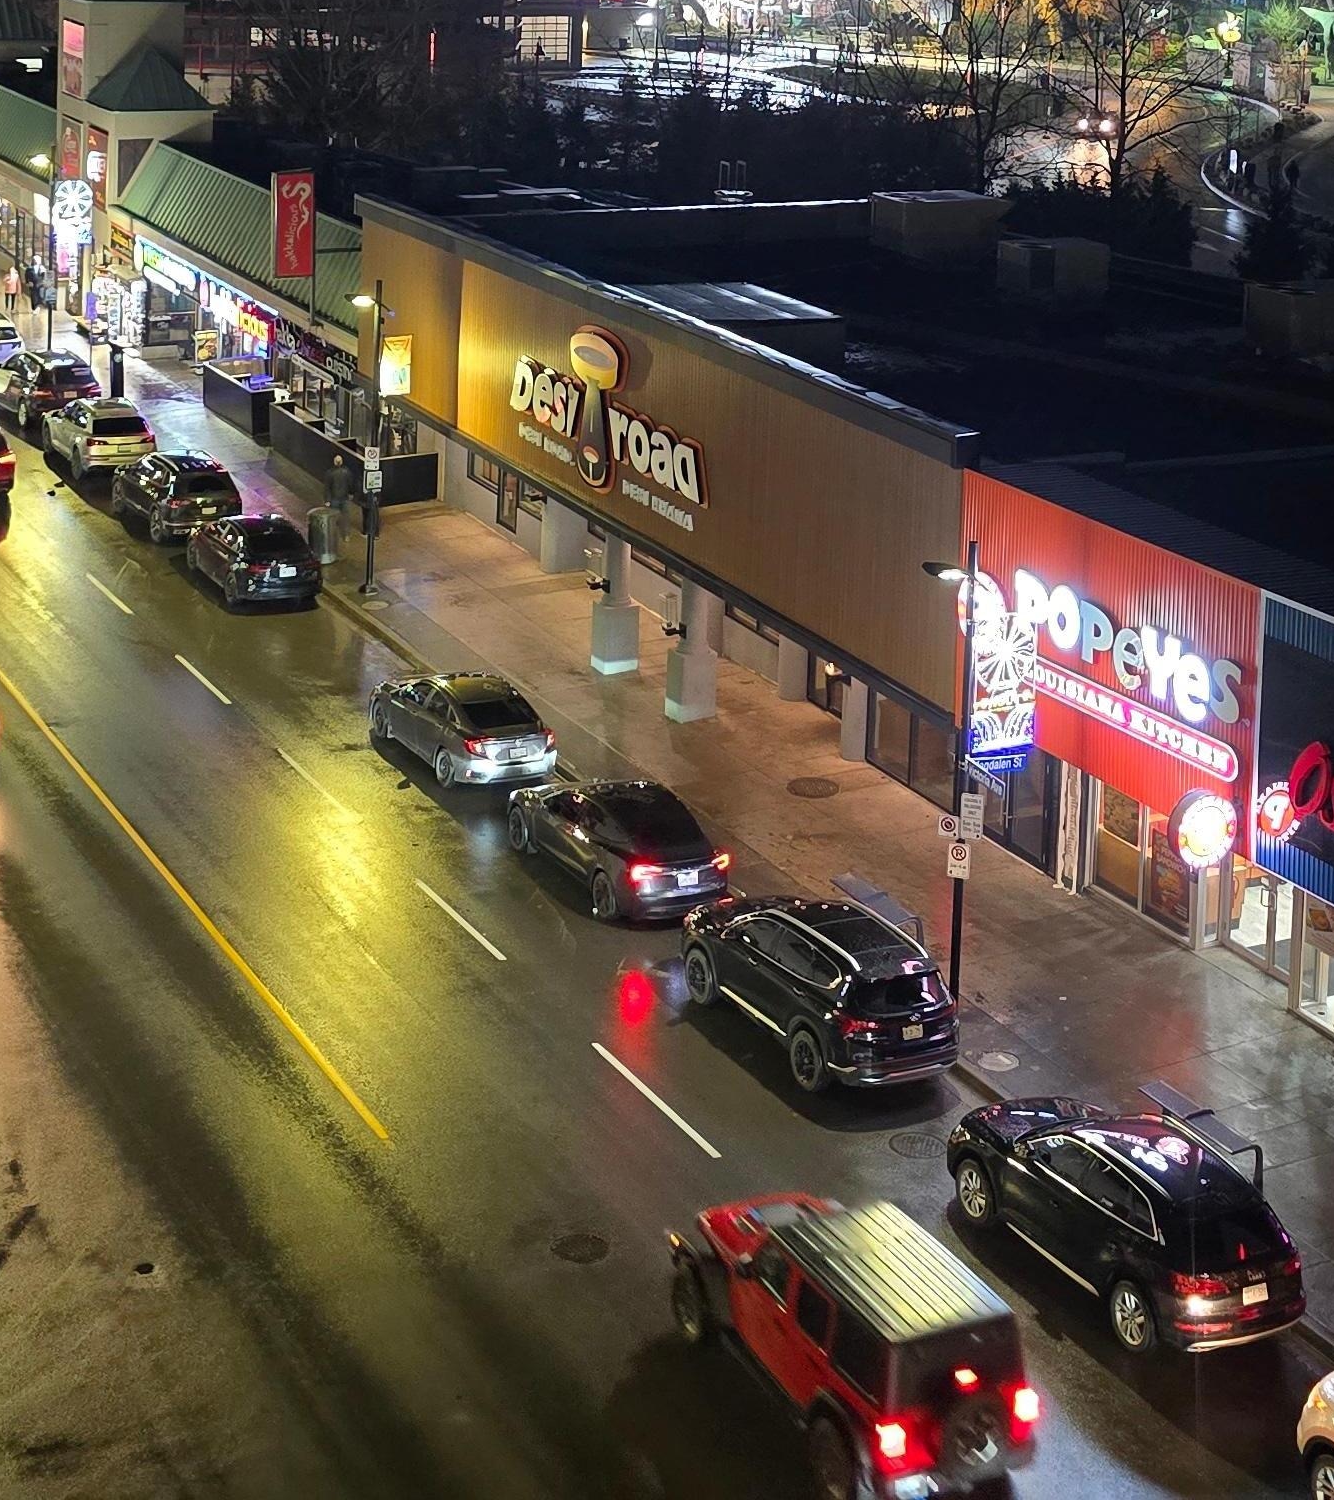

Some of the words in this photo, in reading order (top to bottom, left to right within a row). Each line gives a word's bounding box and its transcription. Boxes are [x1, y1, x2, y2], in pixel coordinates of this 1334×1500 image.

[608, 406, 699, 505] road
[978, 758, 1011, 772] agdalen
[1013, 756, 1023, 768] St
[1023, 660, 1126, 726] LOUISIANA
[1128, 710, 1231, 770] KITCHEN
